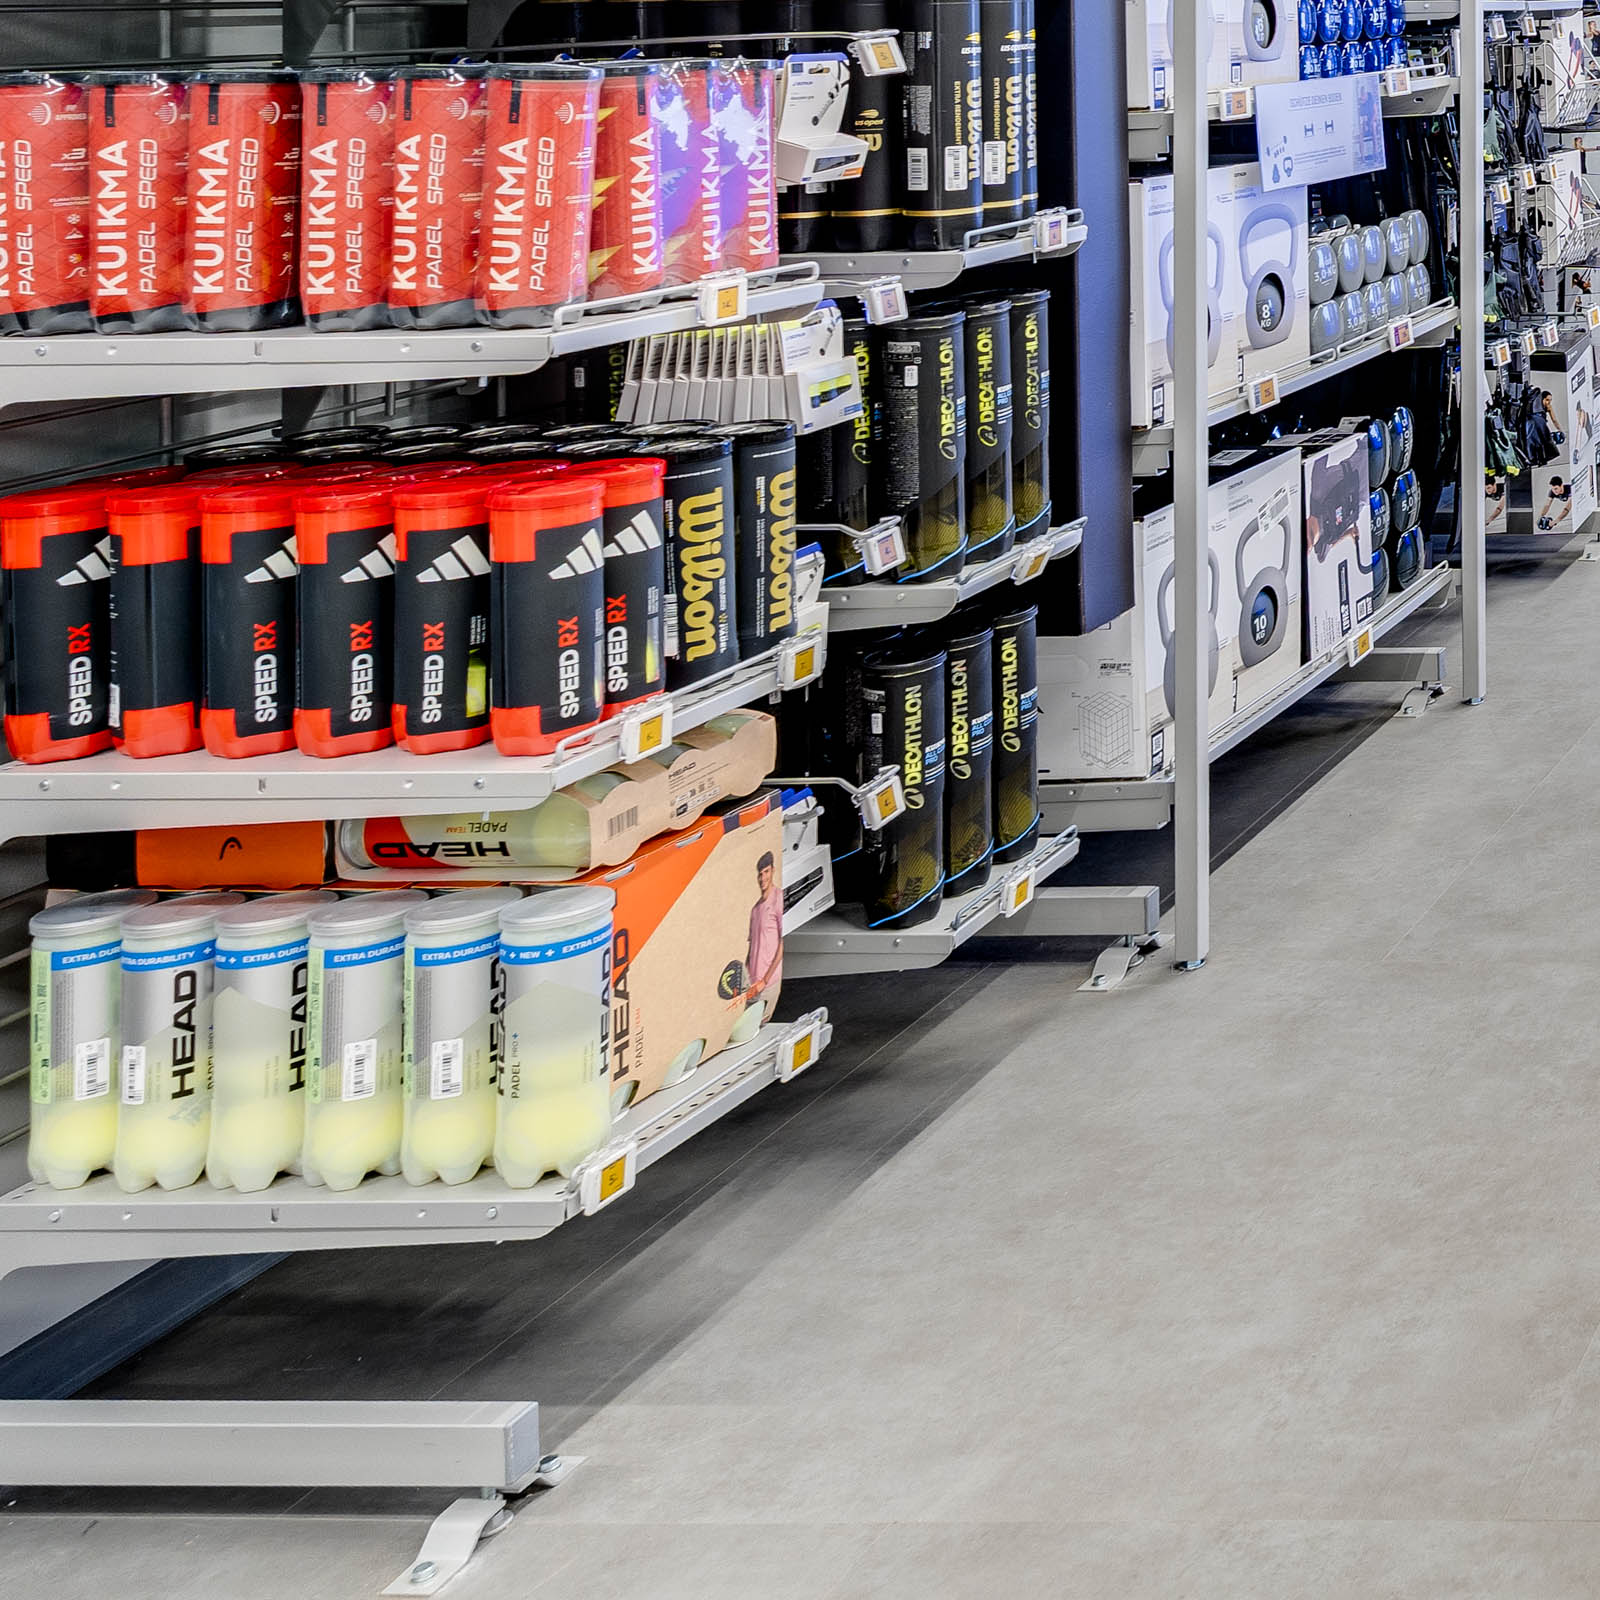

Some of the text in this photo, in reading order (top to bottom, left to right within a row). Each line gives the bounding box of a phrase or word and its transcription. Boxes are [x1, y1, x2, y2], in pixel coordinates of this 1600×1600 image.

[967, 79, 981, 180] Wilson
[1005, 75, 1022, 174] Wilson
[1026, 73, 1037, 169] Wilson
[14, 140, 32, 210] SPEED
[97, 140, 128, 296] KUIKMA
[138, 138, 158, 292] PADEL SPEED
[193, 138, 230, 294] KUIKMA
[236, 137, 259, 292] PADEL SPEED
[307, 138, 338, 295] KUIKMA
[346, 137, 366, 293] PADEL SPEED
[392, 134, 421, 290] KUIKMA
[427, 133, 447, 289] PADEL SPEED
[489, 137, 529, 291] KUIKMA
[529, 136, 556, 291] PADEL SPEED
[630, 126, 656, 275] KUIKMA
[700, 124, 722, 261] KUIKMA
[747, 118, 771, 257] KUIKMA
[17, 223, 34, 295] PADEL
[1025, 312, 1039, 406] DECATHLON
[1261, 305, 1271, 319] 8
[1261, 318, 1272, 328] KG
[939, 337, 956, 444] DECATHLON
[977, 327, 995, 423] DECATHLON
[678, 486, 725, 662] Wilson
[769, 465, 796, 633] Wilson
[253, 621, 277, 723] SPEED RX
[350, 620, 373, 722] SPEED RX
[422, 622, 444, 723] SPEED RX
[559, 616, 579, 718] SPEED RX
[607, 595, 628, 692] SPEED RX
[1254, 615, 1266, 631] 10
[1256, 630, 1265, 640] KG
[68, 622, 93, 726] SPEED RX
[951, 659, 968, 757] DECATHLON
[1003, 637, 1018, 730] DECATHLON
[668, 762, 696, 779] HEAD
[905, 684, 922, 785] DECATHLON
[373, 840, 511, 858] HEAD
[445, 821, 508, 834] PADEL TEAM
[62, 952, 97, 966] EXTRA
[137, 951, 195, 967] DURABILITY
[242, 950, 277, 964] EXTRA
[333, 952, 368, 964] EXTRA
[422, 950, 451, 962] EXTRA
[519, 937, 593, 960] NEW EXTRA
[171, 969, 197, 1100] HEAD
[288, 963, 309, 1093] HEAD
[613, 927, 631, 1080] HEAD
[635, 1025, 644, 1068] PADEL
[512, 1040, 520, 1099] PADEL PRO
